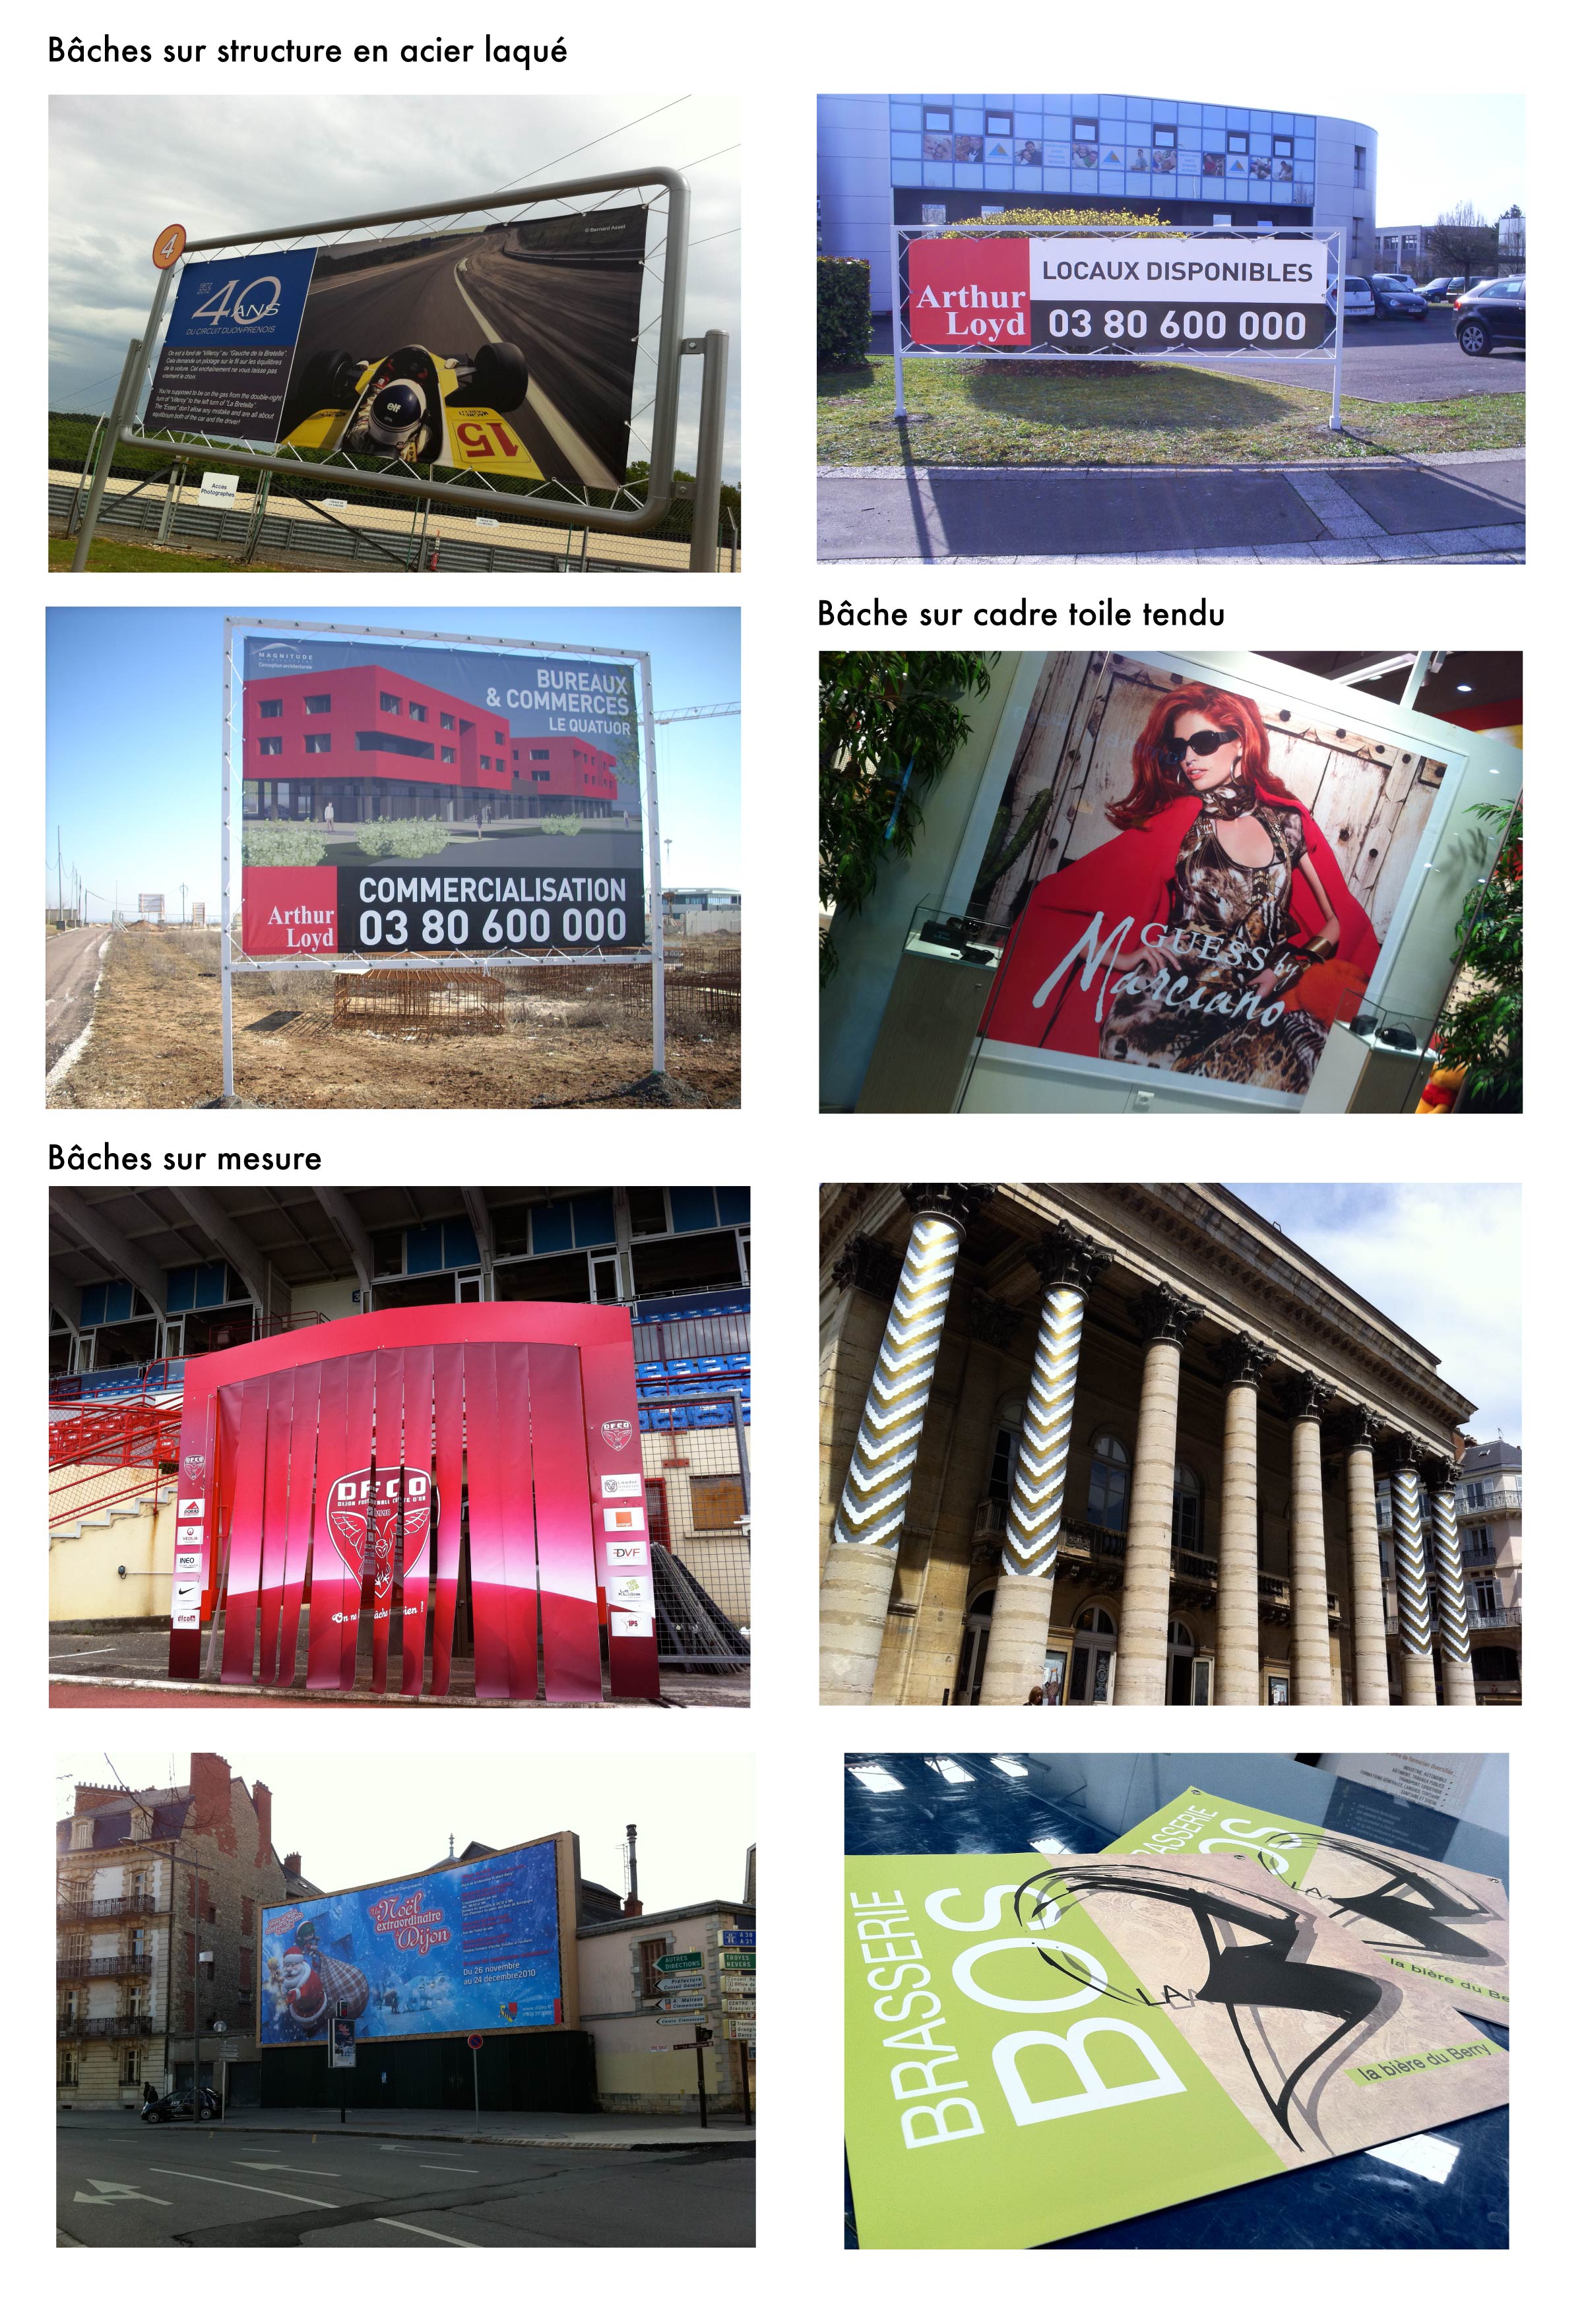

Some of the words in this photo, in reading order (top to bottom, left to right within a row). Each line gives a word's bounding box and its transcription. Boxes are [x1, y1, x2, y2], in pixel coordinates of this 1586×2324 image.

[160, 232, 179, 259] 4
[1043, 261, 1139, 282] LOCAUX
[1147, 262, 1313, 282] DISPONIBLES
[191, 276, 282, 325] 40
[916, 284, 1027, 308] Arthur
[230, 303, 282, 317] ANS
[945, 311, 1027, 342] Loyd
[1049, 309, 1092, 338] 03
[1104, 309, 1148, 338] 80
[1160, 310, 1227, 339] 600
[1239, 311, 1306, 340] 000
[251, 393, 282, 402] double-right
[387, 402, 402, 413] elf
[457, 423, 519, 458] 15
[201, 488, 235, 497] Photographes
[536, 668, 629, 695] BUREAUX
[486, 687, 501, 707] &
[507, 688, 629, 716] COMMERCES
[549, 717, 567, 732] LE
[569, 717, 631, 736] QUATUOR
[359, 877, 627, 902] COMMERCIALISATION
[268, 905, 335, 925] Arthur
[360, 910, 409, 945] 03
[422, 909, 469, 945] 80
[482, 909, 551, 943] 600
[563, 908, 627, 942] 000
[286, 928, 334, 952] Loyd
[1032, 911, 1285, 1028] Marciano
[1141, 922, 1270, 971] GUESS
[1273, 951, 1301, 990] by
[338, 1477, 426, 1501] DFCO
[614, 1548, 640, 1557] DVF
[377, 1893, 422, 1921] Noël
[377, 1912, 441, 1931] extraordinaire
[398, 1926, 447, 1953] Dijon
[486, 1962, 520, 1972] novembre
[665, 1961, 700, 1969] DIRECTIONS
[1390, 1958, 1405, 1969] la
[1411, 1964, 1454, 1984] bière
[1461, 1982, 1482, 1994] du
[924, 1883, 1188, 2127] BOS
[849, 1889, 985, 2150] BRASSERIE
[1357, 2067, 1381, 2081] la
[1378, 2060, 1426, 2077] bière
[1426, 2053, 1449, 2066] du
[1447, 2044, 1492, 2061] Berry
